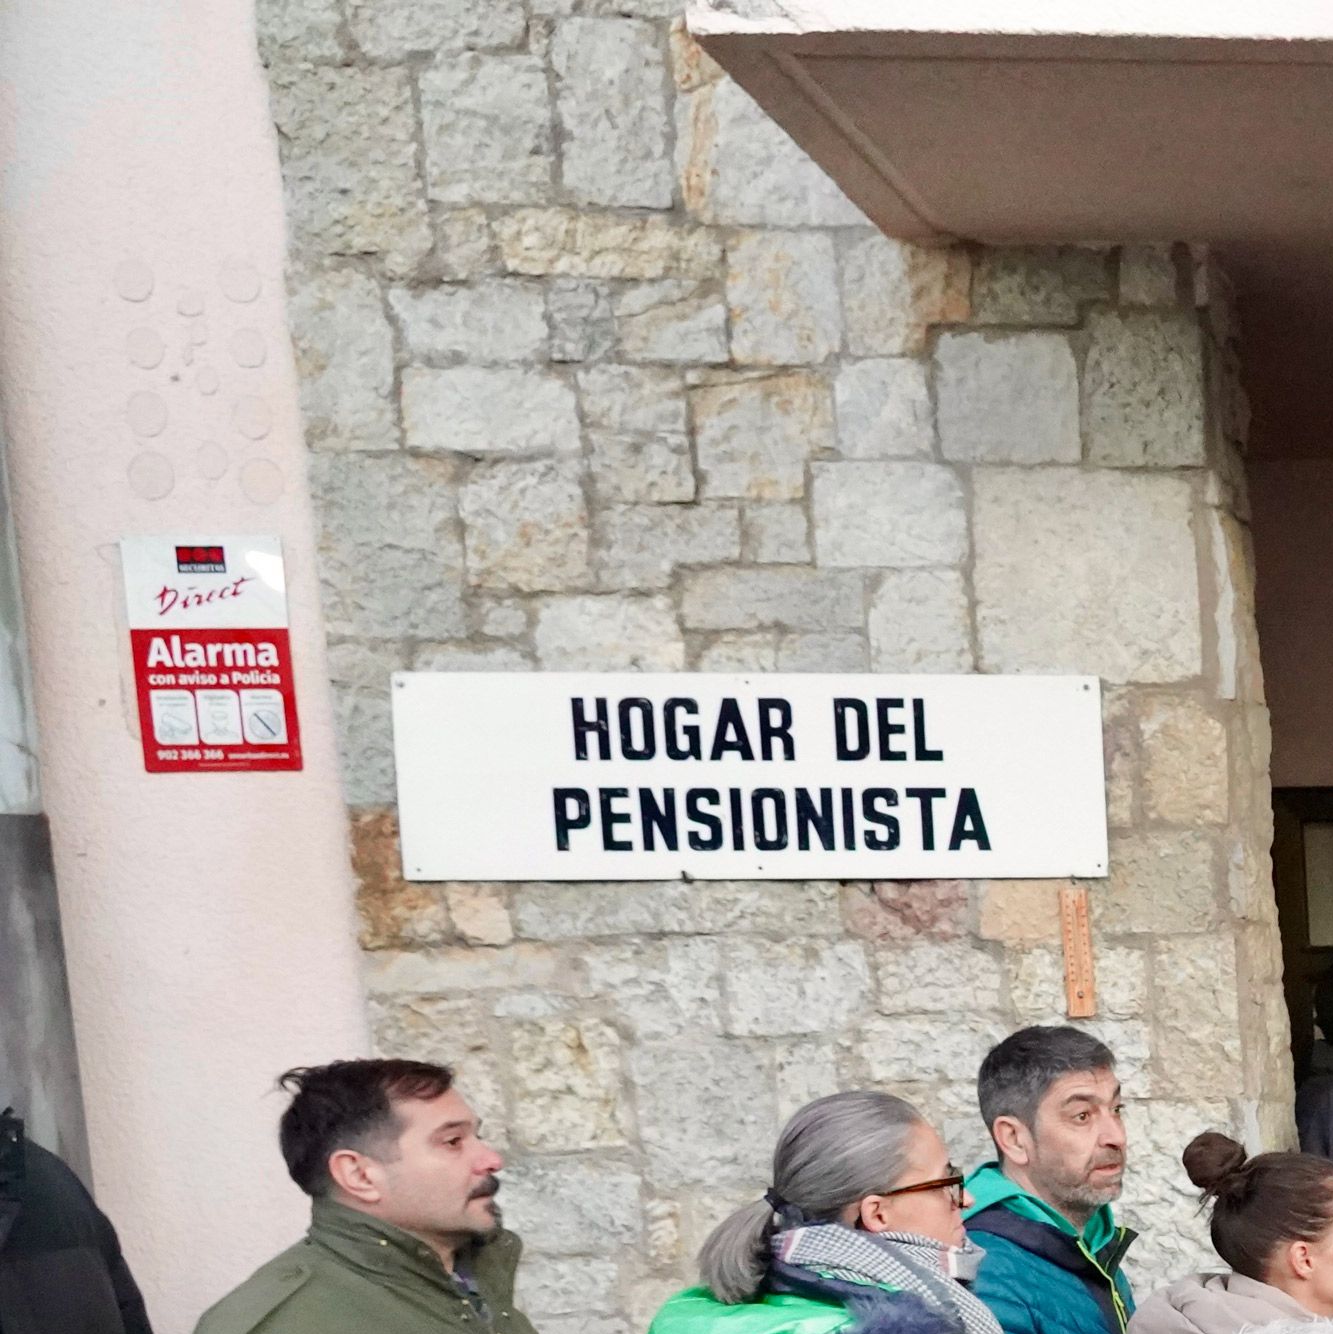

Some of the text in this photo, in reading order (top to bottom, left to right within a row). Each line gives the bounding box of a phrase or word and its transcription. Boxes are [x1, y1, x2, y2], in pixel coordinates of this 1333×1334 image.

[155, 577, 256, 616] Direct
[147, 635, 279, 669] Alarma
[148, 673, 176, 685] con
[178, 670, 217, 685] aviso
[219, 673, 230, 685] a
[571, 697, 944, 762] HOGAR DEL
[552, 787, 992, 852] PENSIONISTA
